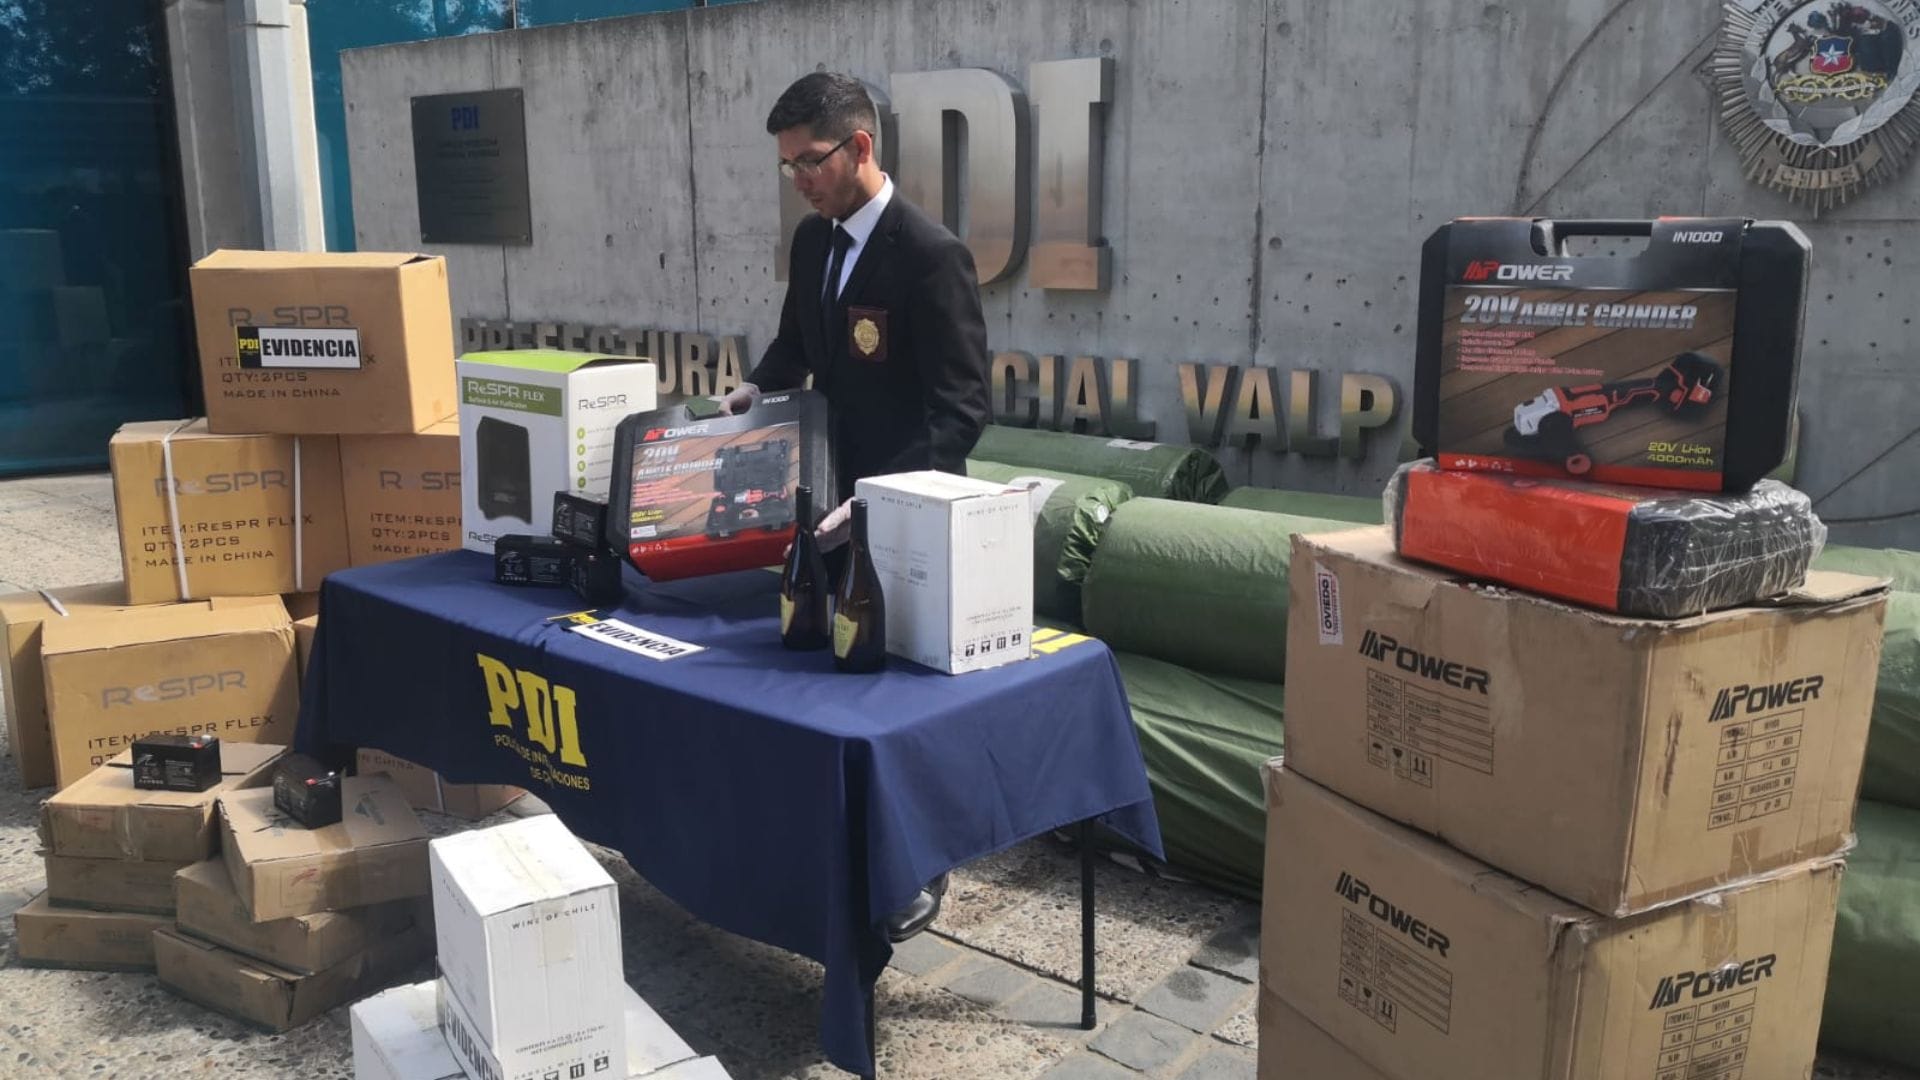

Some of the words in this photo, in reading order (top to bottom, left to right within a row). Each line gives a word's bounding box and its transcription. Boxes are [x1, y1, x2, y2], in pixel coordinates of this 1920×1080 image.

[451, 105, 480, 131] PDI
[774, 57, 1114, 292] DI
[1778, 164, 1859, 188] CHILE
[1673, 231, 1723, 244] IN1000
[1460, 295, 1519, 325] 20V
[1517, 302, 1589, 327] ANGLE
[1592, 304, 1698, 329] GRINDER
[239, 338, 260, 351] PDI
[262, 338, 358, 358] EVIDENCIA
[222, 371, 308, 384] QTY:2PCS
[223, 389, 265, 399] MADE
[271, 389, 287, 398] IN
[292, 388, 341, 398] CHINA
[467, 380, 520, 399] ReSPR
[523, 389, 545, 402] FLEX
[578, 394, 627, 410] ReSPR
[1178, 363, 1424, 460] VALP
[1647, 453, 1714, 466] 4000mAh
[1648, 441, 1677, 454] 20V
[1681, 443, 1712, 456] Li-ion
[370, 513, 463, 526] ITEM:RESP
[199, 552, 216, 563] IN
[223, 549, 275, 563] CHINA
[1322, 578, 1333, 630] OVIEDO
[587, 622, 686, 656] EVIDENCIA
[103, 668, 247, 709] ReSPR
[476, 652, 588, 768] PDI
[226, 713, 275, 732] FLEX
[511, 917, 541, 930] WINE
[545, 913, 559, 922] OF
[564, 903, 596, 917] CHILE
[444, 1000, 503, 1080] EVIDENC
